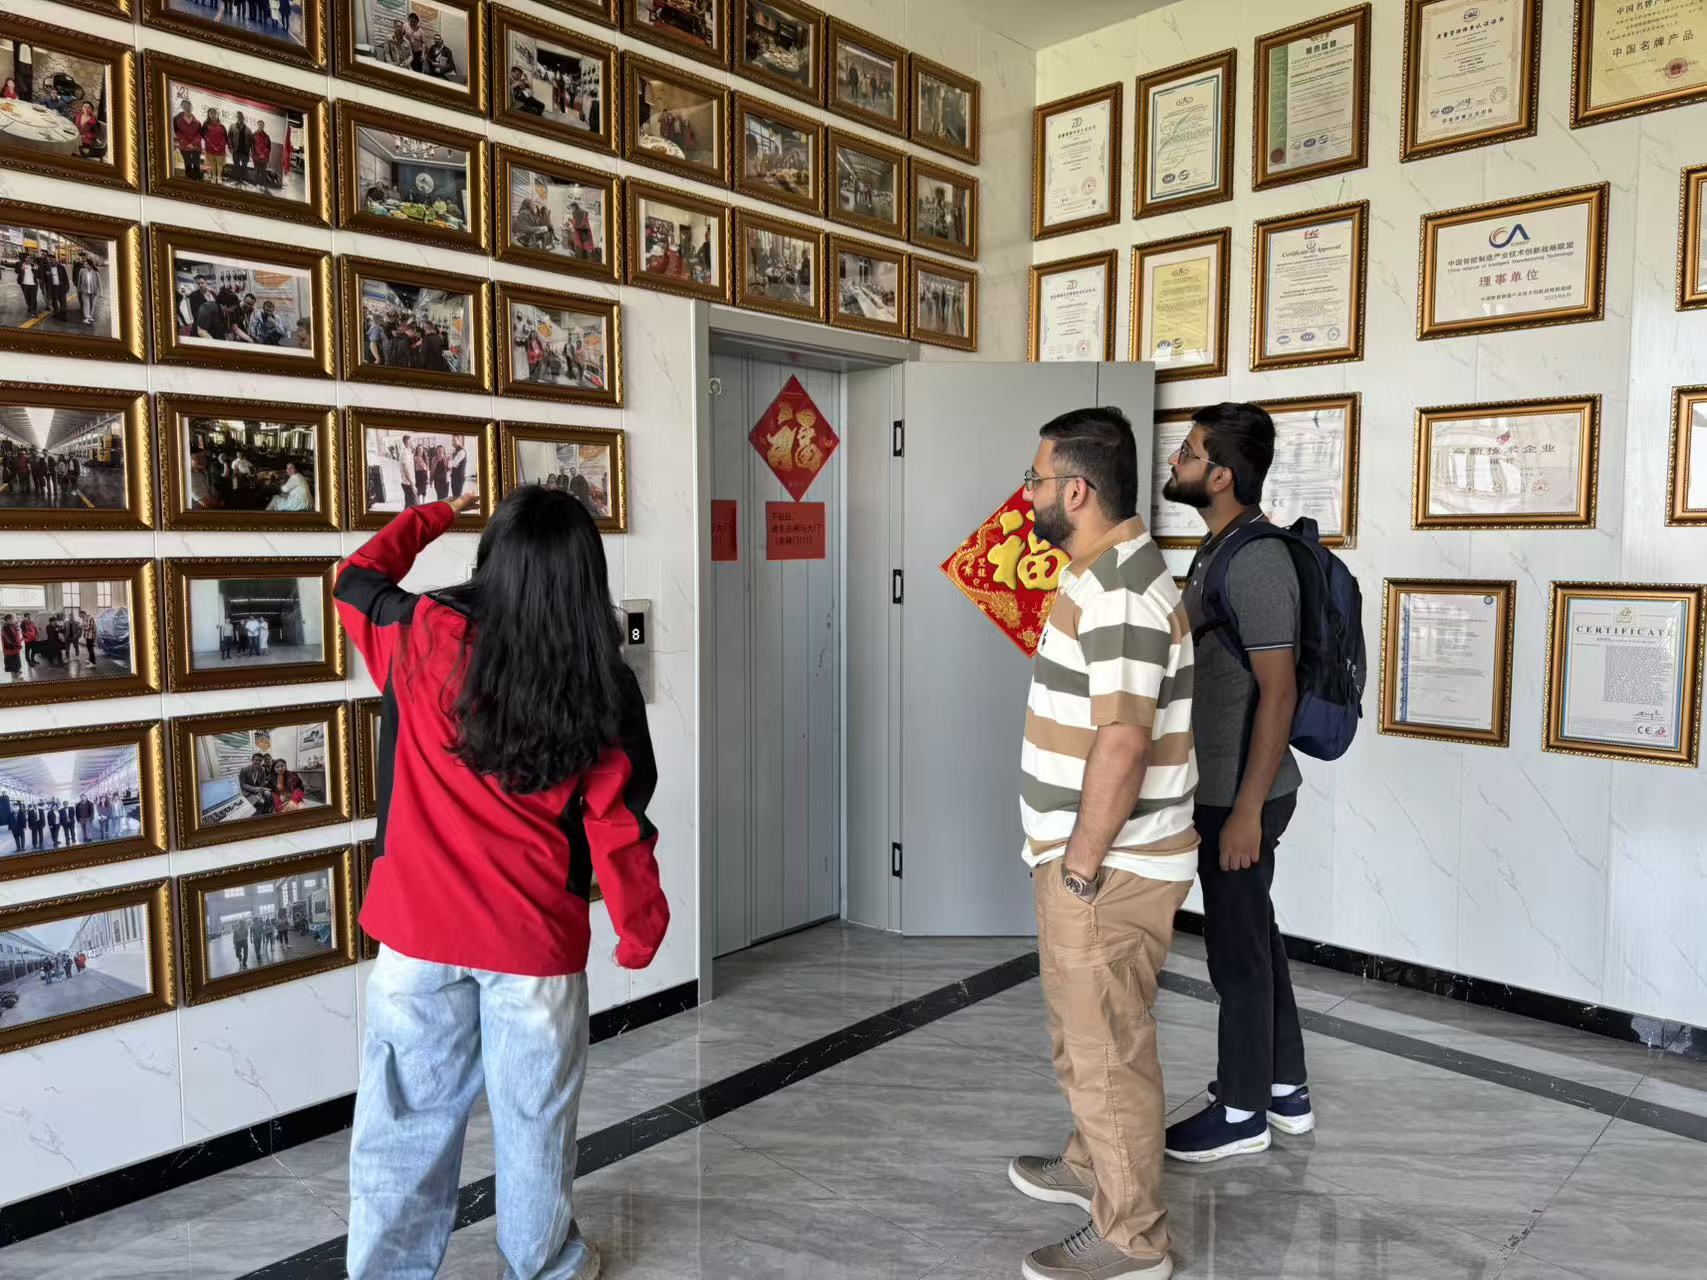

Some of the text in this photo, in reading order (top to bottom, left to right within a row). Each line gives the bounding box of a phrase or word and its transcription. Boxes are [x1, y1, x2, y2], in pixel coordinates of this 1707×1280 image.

[1612, 29, 1694, 58] 中国名牌产品
[1479, 269, 1540, 288] 理事单位
[766, 400, 823, 473] 福
[1452, 443, 1556, 456] 高新技术企业
[988, 509, 1072, 591] 福
[632, 628, 640, 640] 8
[1576, 625, 1674, 637] CERTIFICATE
